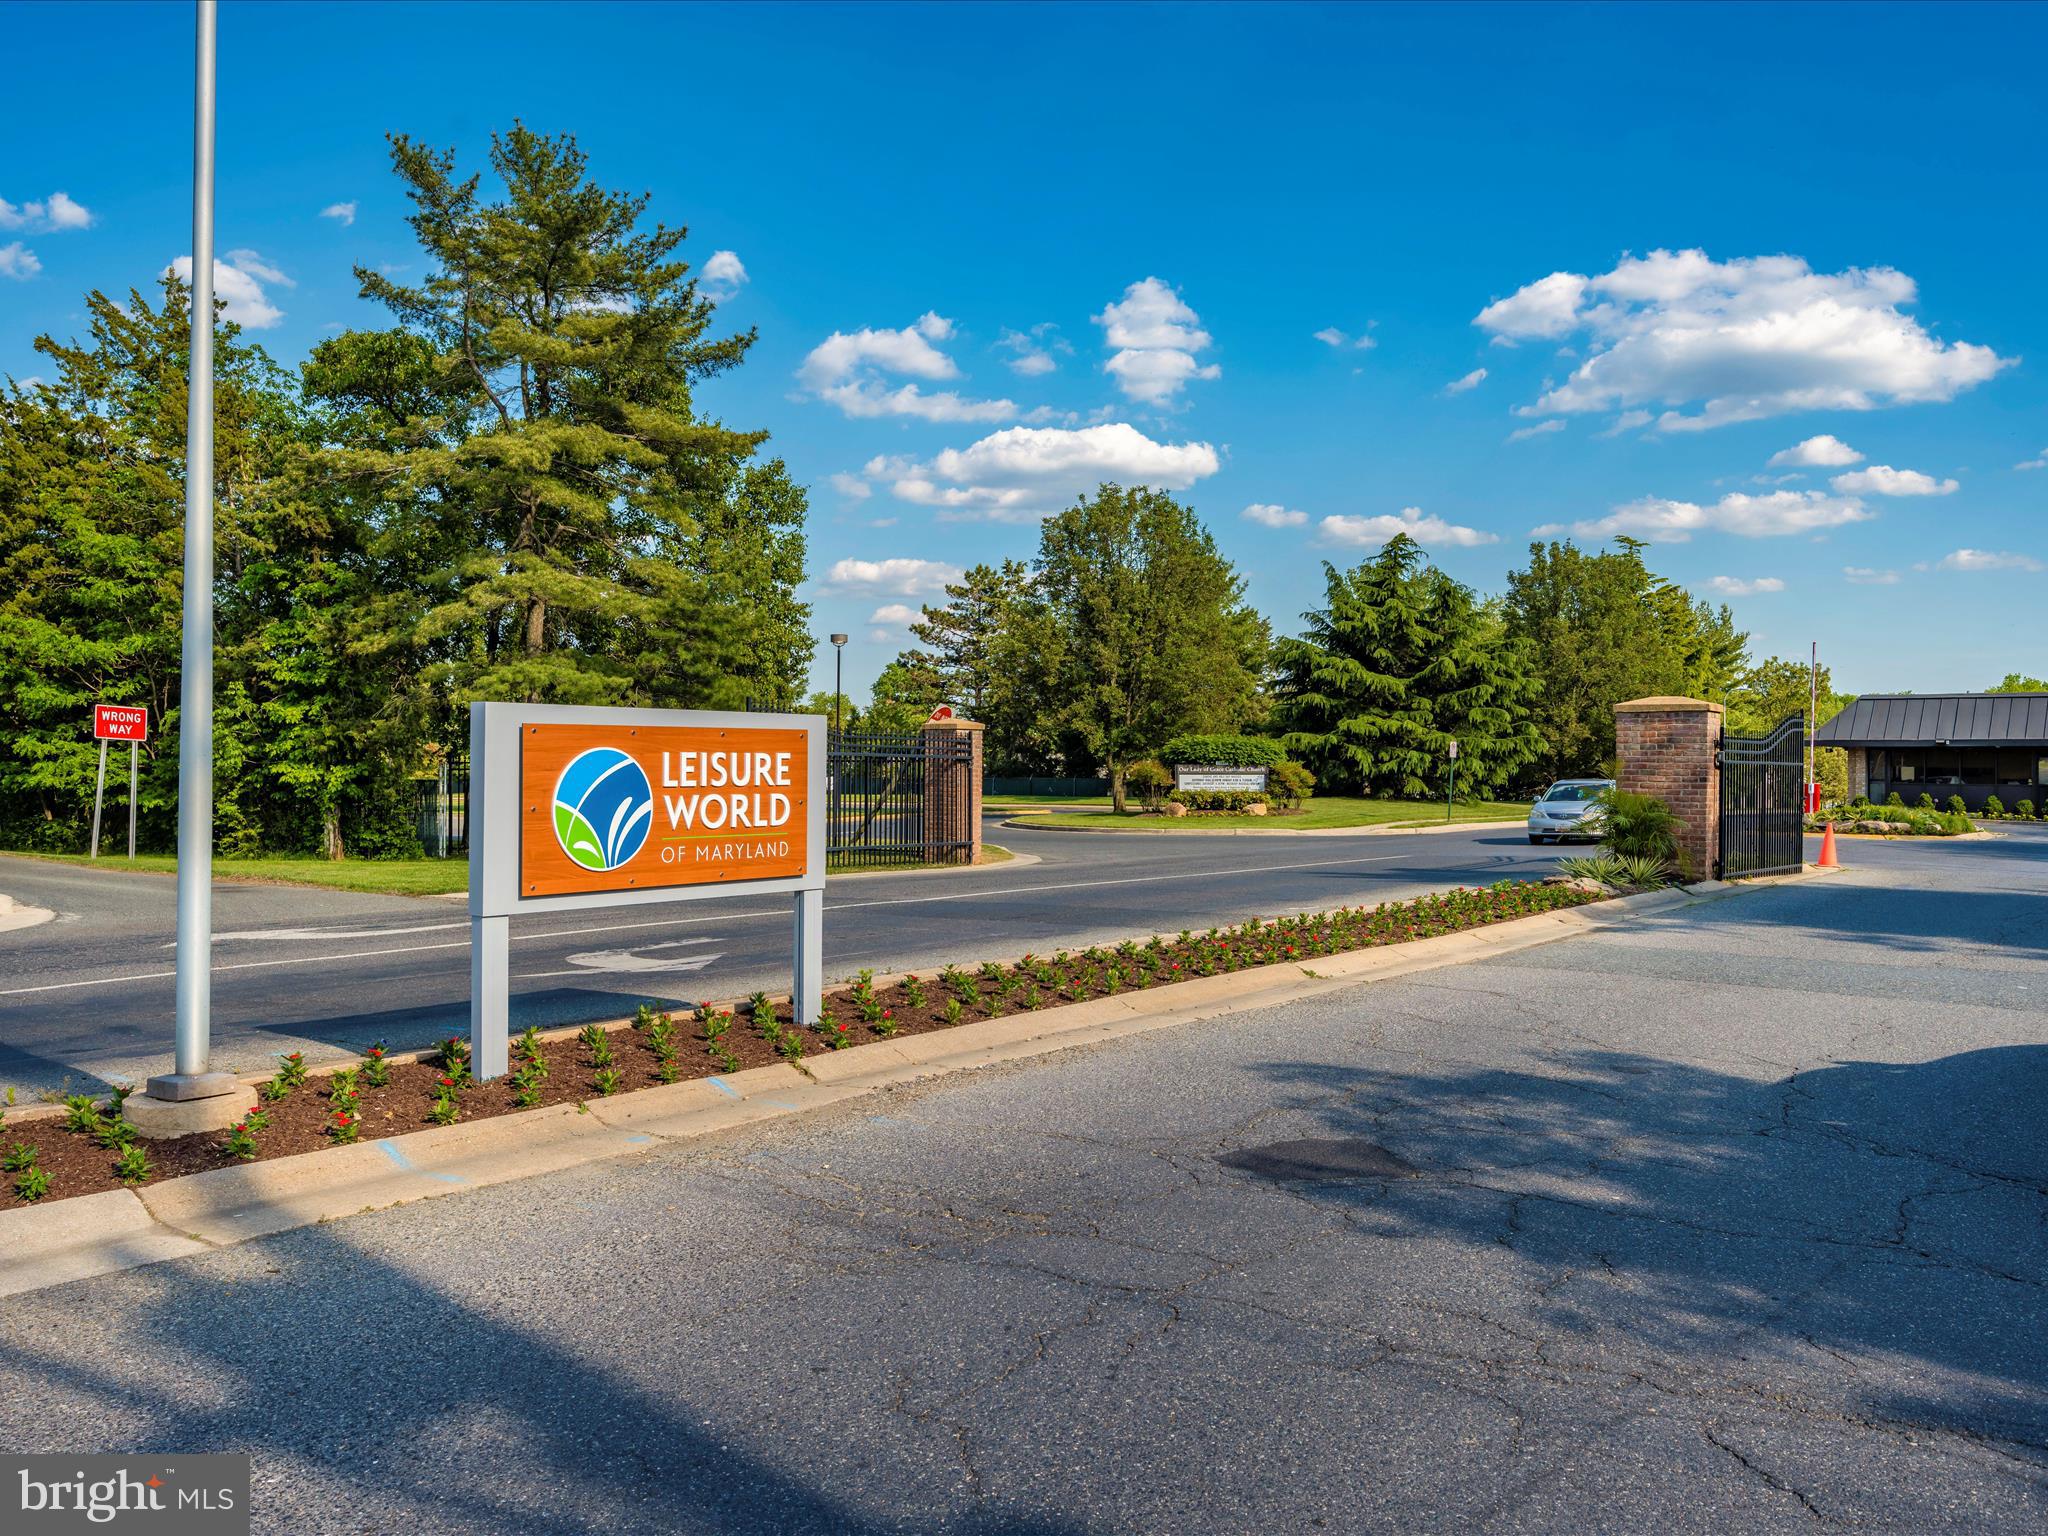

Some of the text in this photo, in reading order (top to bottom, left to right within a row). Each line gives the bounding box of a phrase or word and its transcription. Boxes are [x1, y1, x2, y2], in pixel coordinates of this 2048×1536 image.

[101, 710, 141, 723] WRONG
[109, 723, 133, 735] WAY
[662, 751, 792, 788] LEISURE
[663, 793, 791, 831] WORLD
[661, 841, 789, 863] OF MARYLAND
